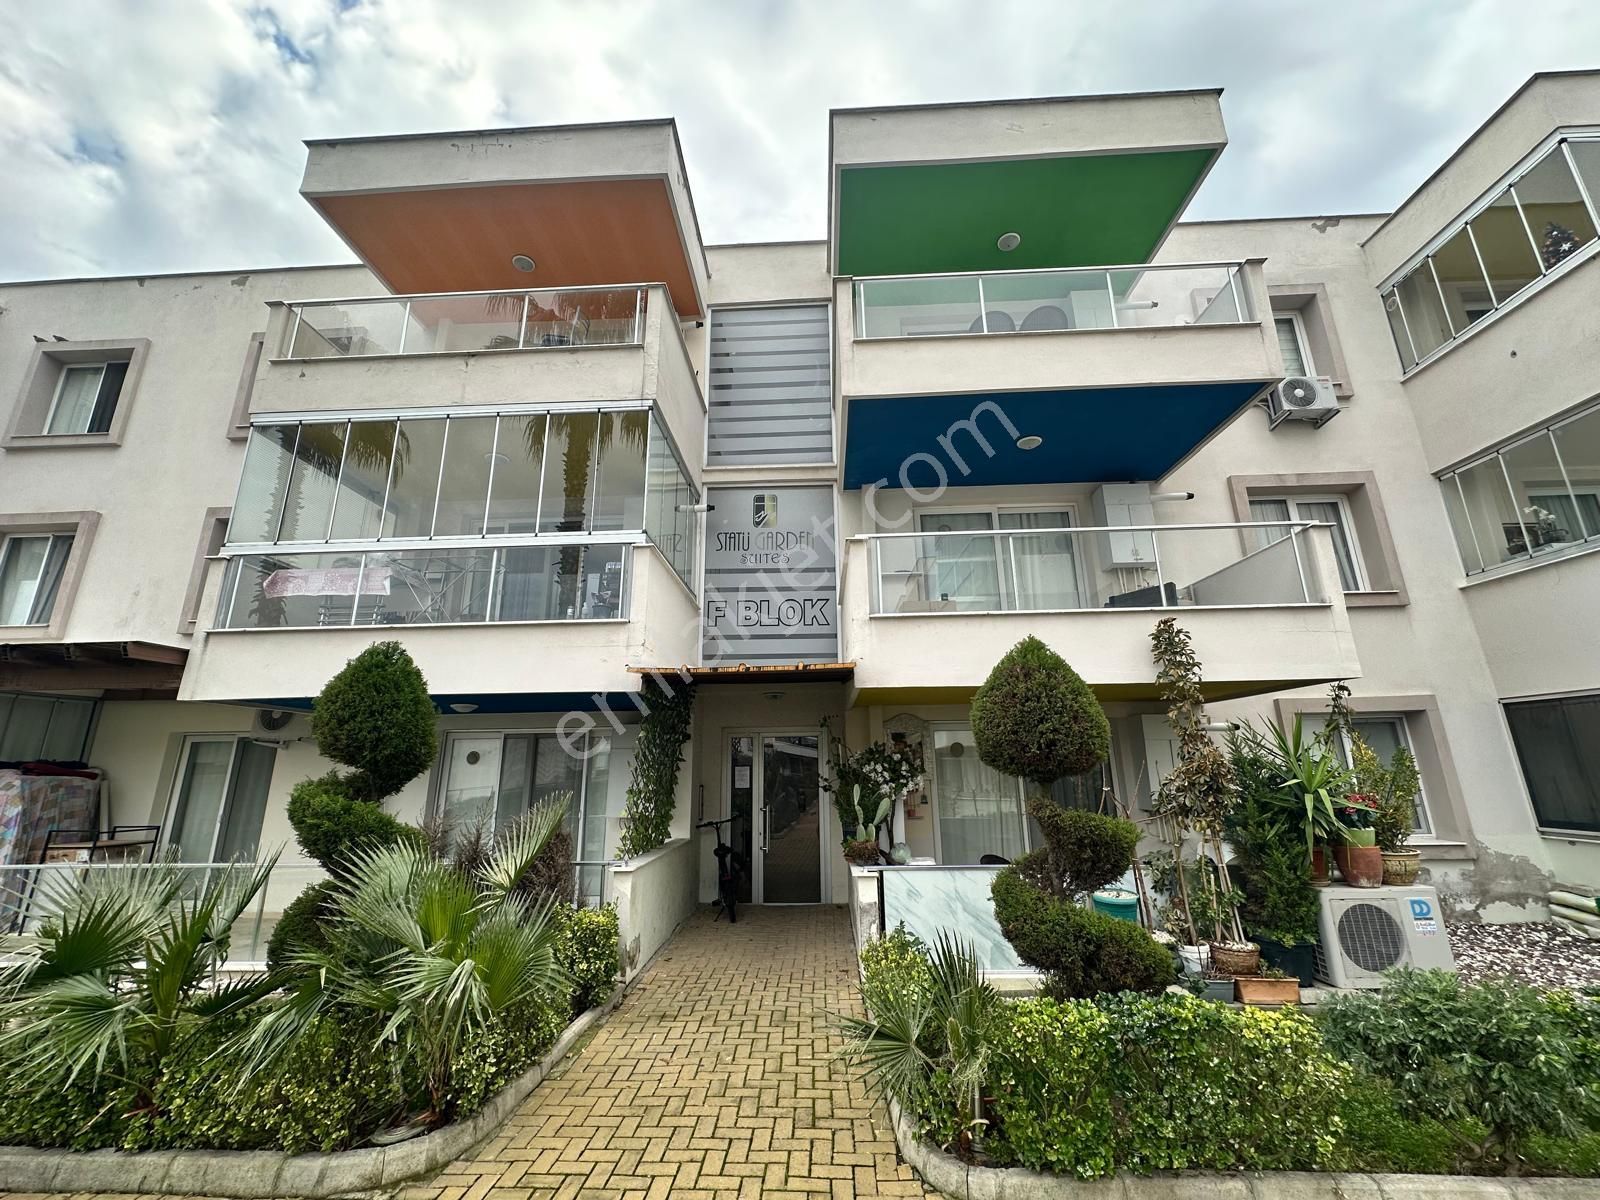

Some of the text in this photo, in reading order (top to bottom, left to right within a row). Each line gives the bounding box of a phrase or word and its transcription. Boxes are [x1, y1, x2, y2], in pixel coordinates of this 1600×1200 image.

[715, 531, 750, 551] STATÜ
[707, 598, 830, 627] F BLOK
